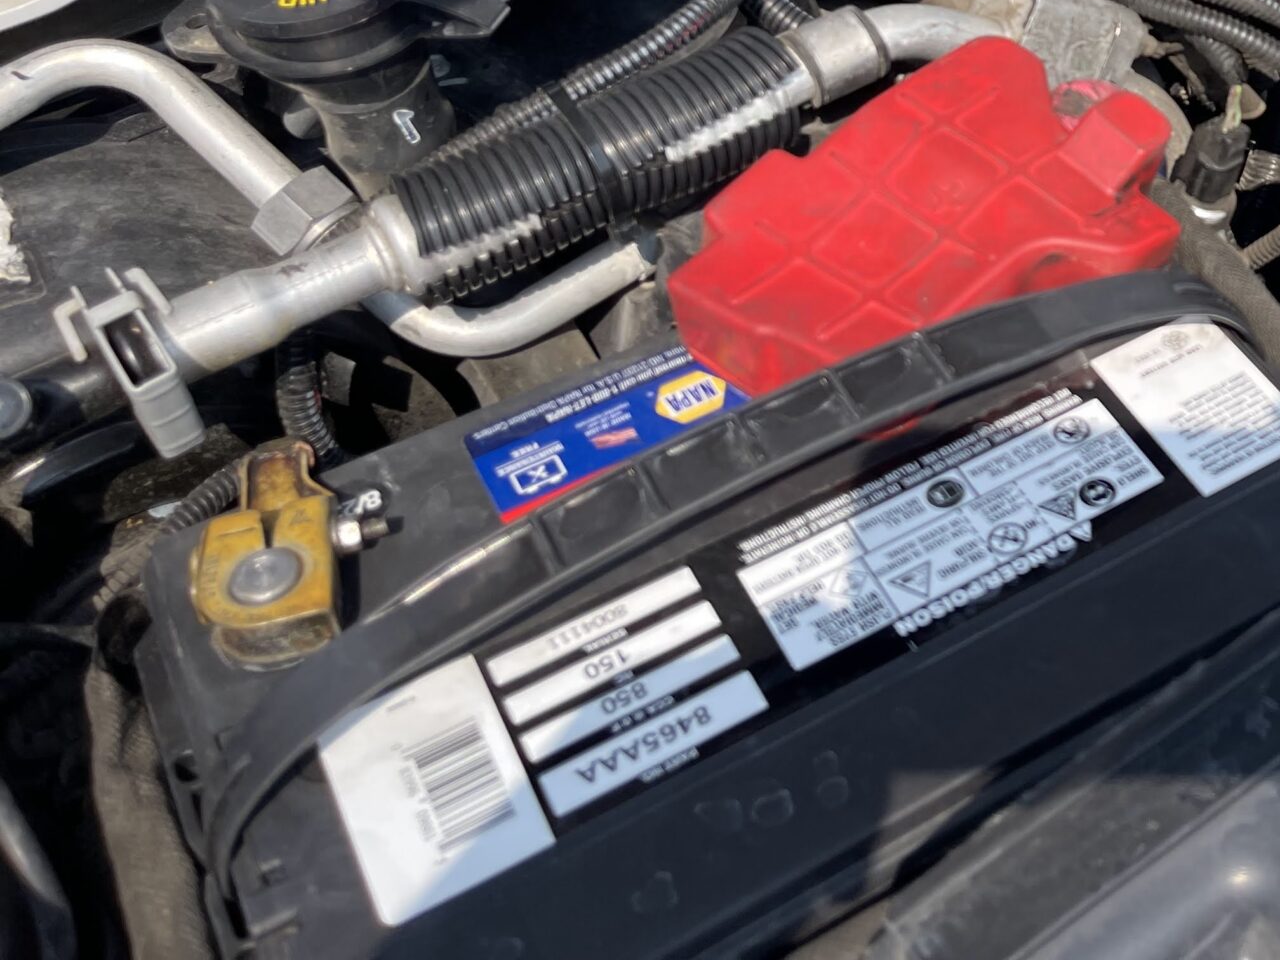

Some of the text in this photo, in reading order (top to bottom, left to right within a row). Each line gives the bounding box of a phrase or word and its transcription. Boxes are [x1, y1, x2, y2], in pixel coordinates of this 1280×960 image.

[505, 398, 559, 428] Distribution
[660, 378, 724, 414] NAPA
[495, 441, 565, 479] MAINTENANCE
[508, 439, 540, 460] FREE
[1080, 444, 1135, 476] EXPLOSIVE
[890, 530, 1079, 640] DANGER/POISON
[580, 646, 629, 681] 150
[597, 679, 649, 717] 850
[573, 700, 713, 790] 8465AAA
